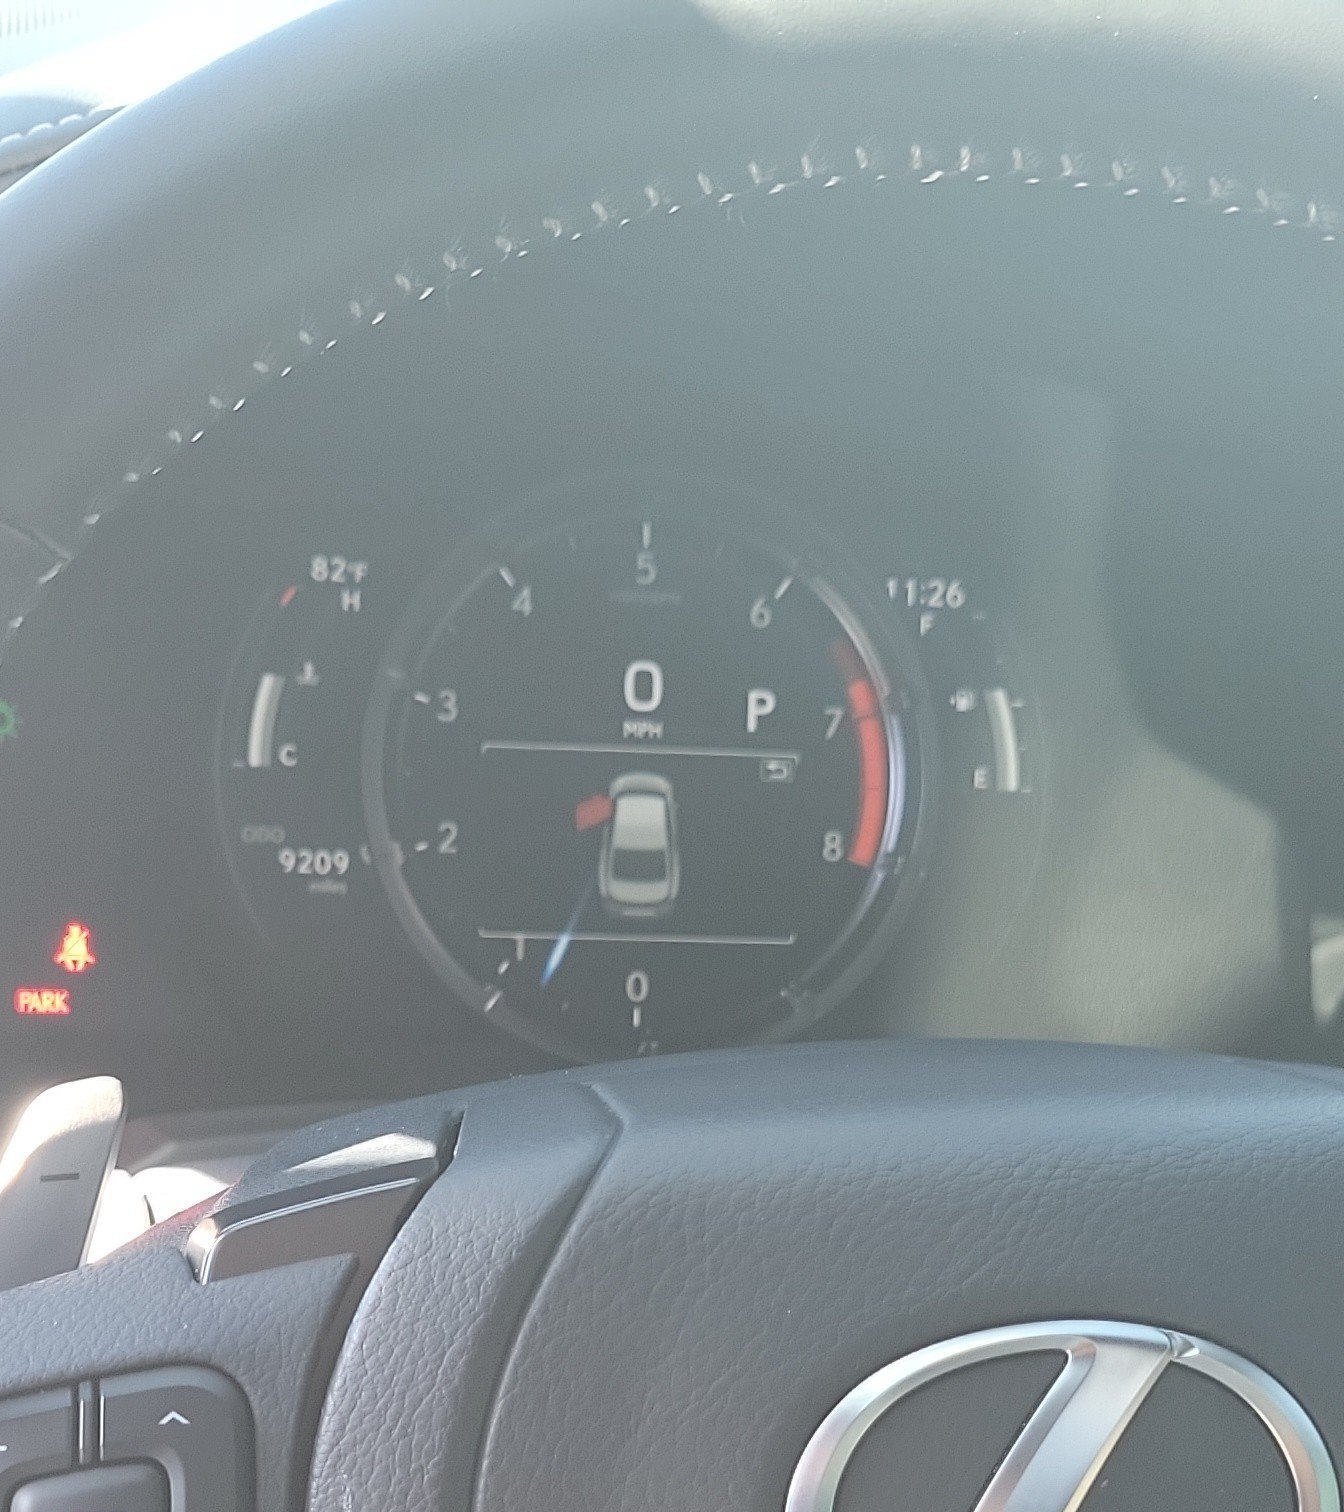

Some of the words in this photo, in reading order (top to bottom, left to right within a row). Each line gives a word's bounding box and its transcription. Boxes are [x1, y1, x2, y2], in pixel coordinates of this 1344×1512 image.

[635, 551, 657, 585] 5
[340, 588, 362, 612] H
[512, 585, 534, 617] 4
[886, 576, 966, 609] 11:26
[749, 594, 773, 629] 6
[437, 689, 458, 723] 3
[746, 688, 777, 734] P
[823, 706, 844, 740] 7
[438, 820, 458, 854] 2
[822, 830, 844, 863] 8
[278, 847, 351, 876] 9209
[14, 988, 72, 1014] PARK
[625, 970, 650, 1003] 0
